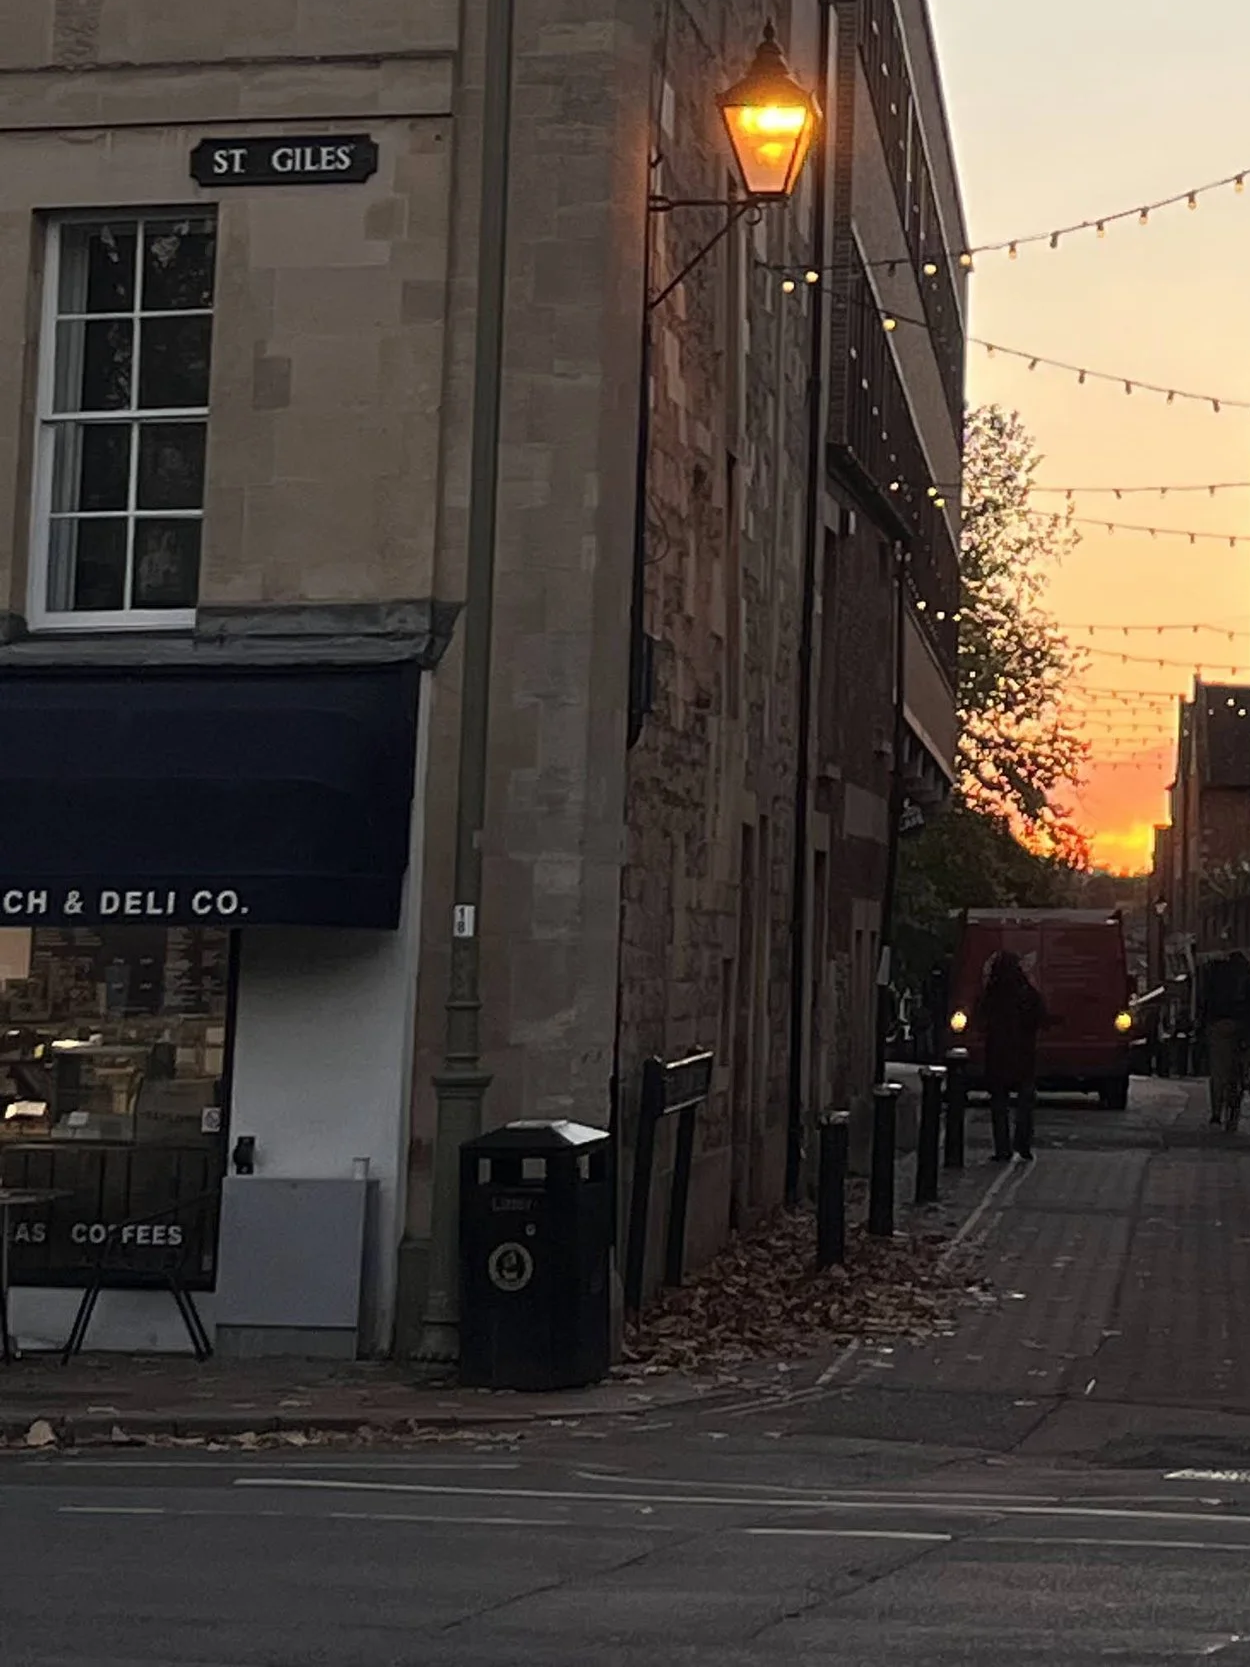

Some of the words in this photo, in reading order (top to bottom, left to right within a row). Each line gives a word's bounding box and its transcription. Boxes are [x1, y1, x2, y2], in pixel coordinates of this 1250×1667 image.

[3, 889, 49, 915] CH
[63, 889, 86, 916] &
[99, 890, 177, 915] DELI
[191, 889, 250, 916] CO.
